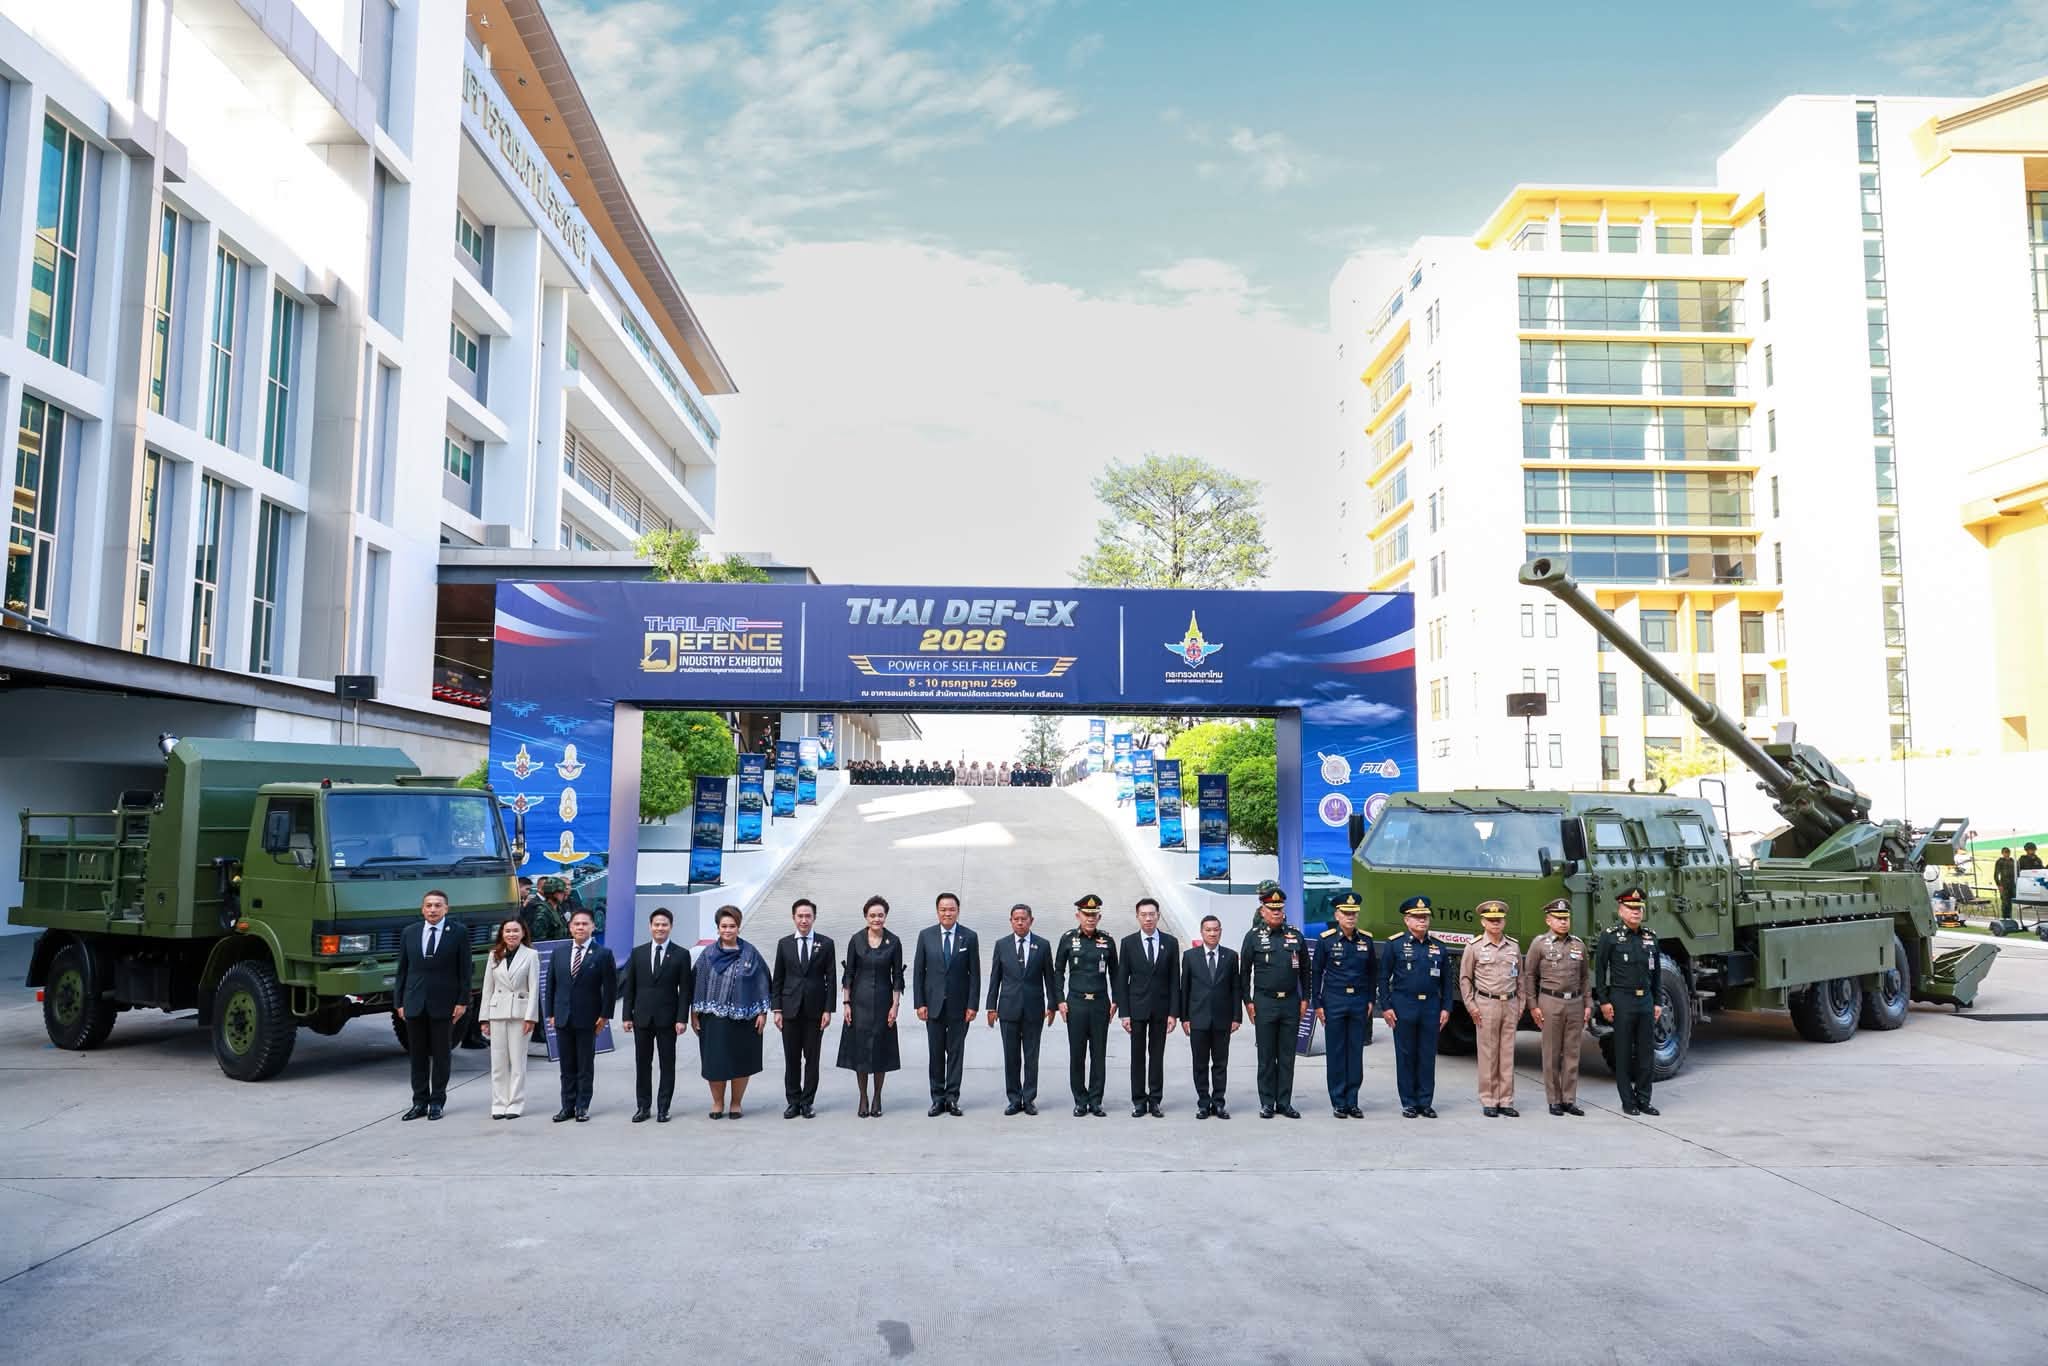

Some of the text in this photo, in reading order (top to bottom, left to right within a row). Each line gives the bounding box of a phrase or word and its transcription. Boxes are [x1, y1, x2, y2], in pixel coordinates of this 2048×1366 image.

[846, 597, 1079, 627] THAI DEF-EX
[643, 615, 749, 633] THAILAND
[919, 628, 1007, 652] 2026
[643, 632, 783, 673] DEFENCE
[679, 655, 783, 668] INDUSTRY EXHIBITION
[888, 660, 1039, 673] POWER OF SELF-RELIANCE
[907, 678, 916, 688] 8
[925, 678, 939, 688] 10
[941, 679, 988, 690] กรกฎาคม
[990, 678, 1018, 689] 2569
